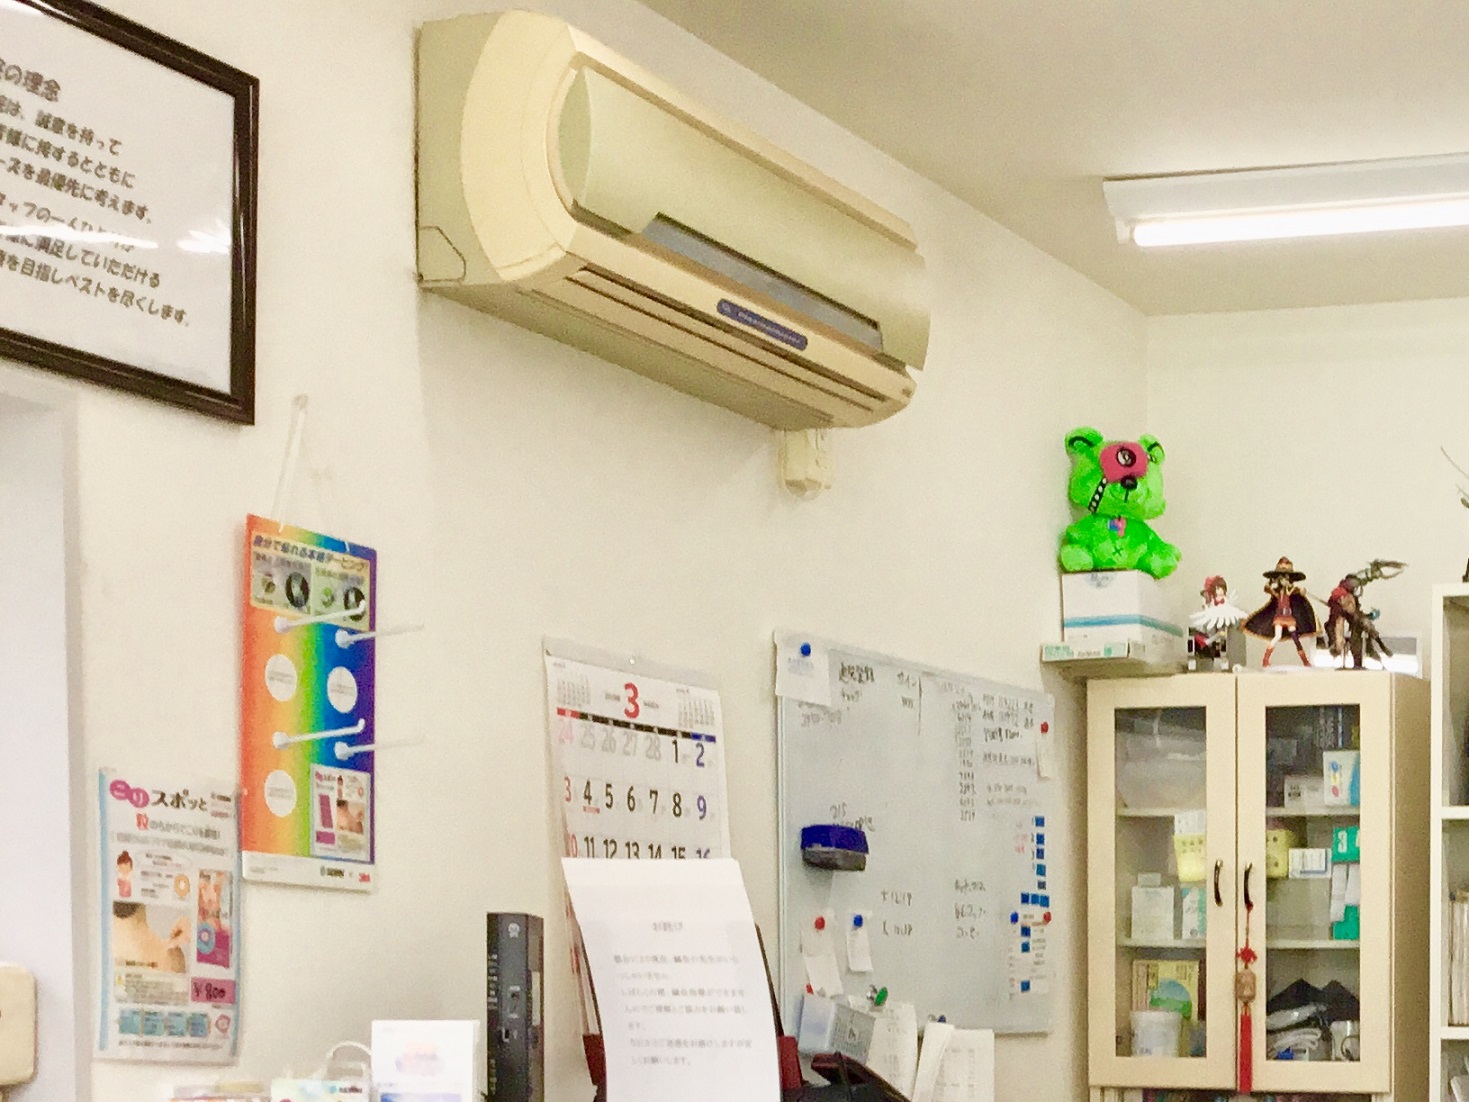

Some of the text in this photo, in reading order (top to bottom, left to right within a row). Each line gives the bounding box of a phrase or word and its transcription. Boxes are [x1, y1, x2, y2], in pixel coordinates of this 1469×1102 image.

[0, 57, 61, 102] の理念
[624, 682, 641, 719] 3
[672, 740, 679, 763] 1
[696, 743, 705, 767] 2
[564, 776, 707, 820] 3 4 5 6 7 8 9
[603, 838, 617, 859] 12
